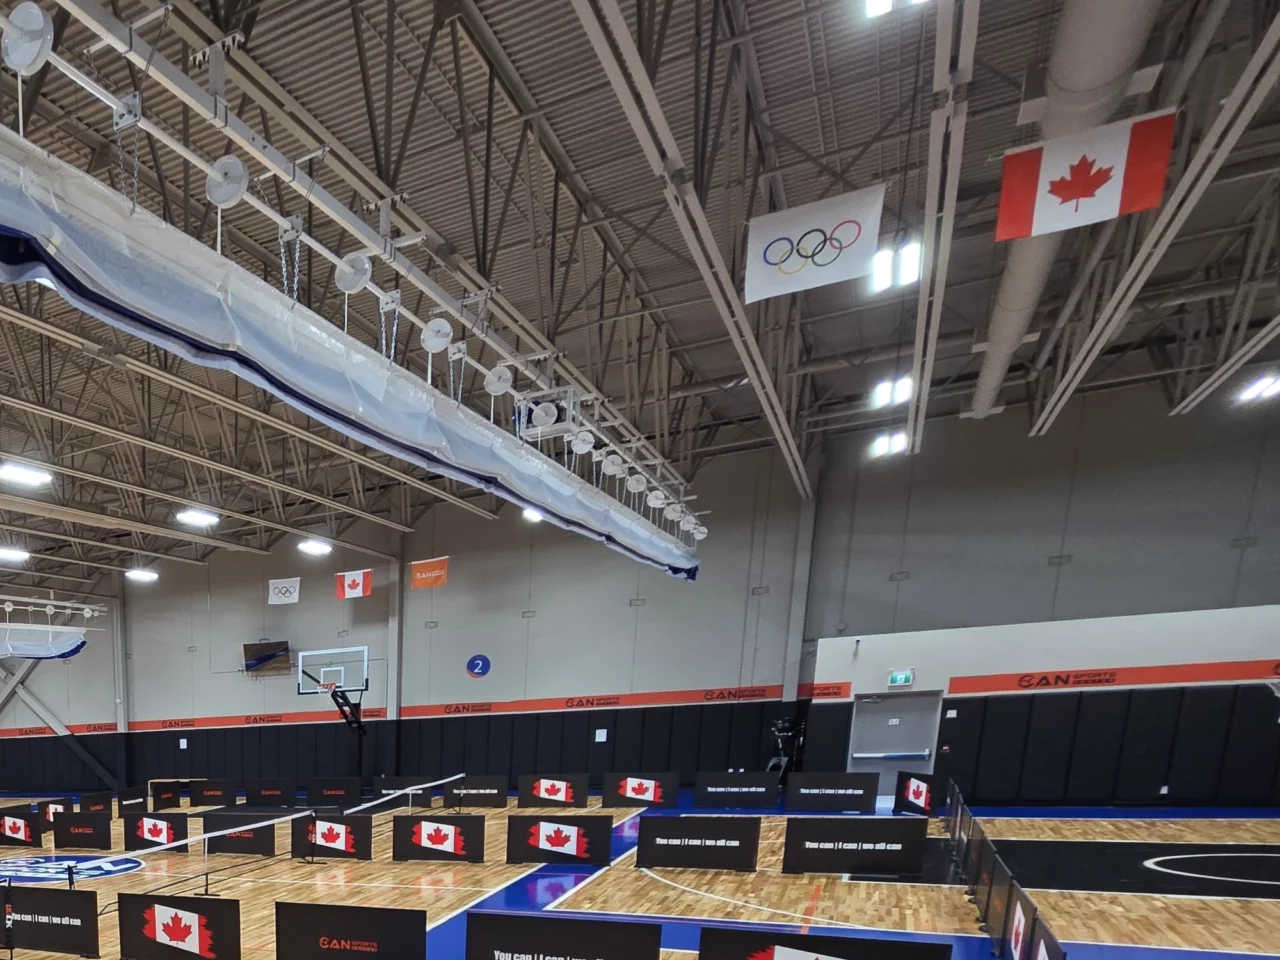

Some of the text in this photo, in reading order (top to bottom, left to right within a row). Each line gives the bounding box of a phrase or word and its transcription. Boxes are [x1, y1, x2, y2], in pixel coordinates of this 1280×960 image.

[473, 660, 483, 673] 2
[1018, 674, 1070, 688] CAN
[656, 837, 668, 845] You
[716, 839, 726, 847] all
[805, 841, 819, 849] You
[874, 842, 886, 850] all
[319, 936, 351, 949] CAN
[494, 950, 512, 960] You
